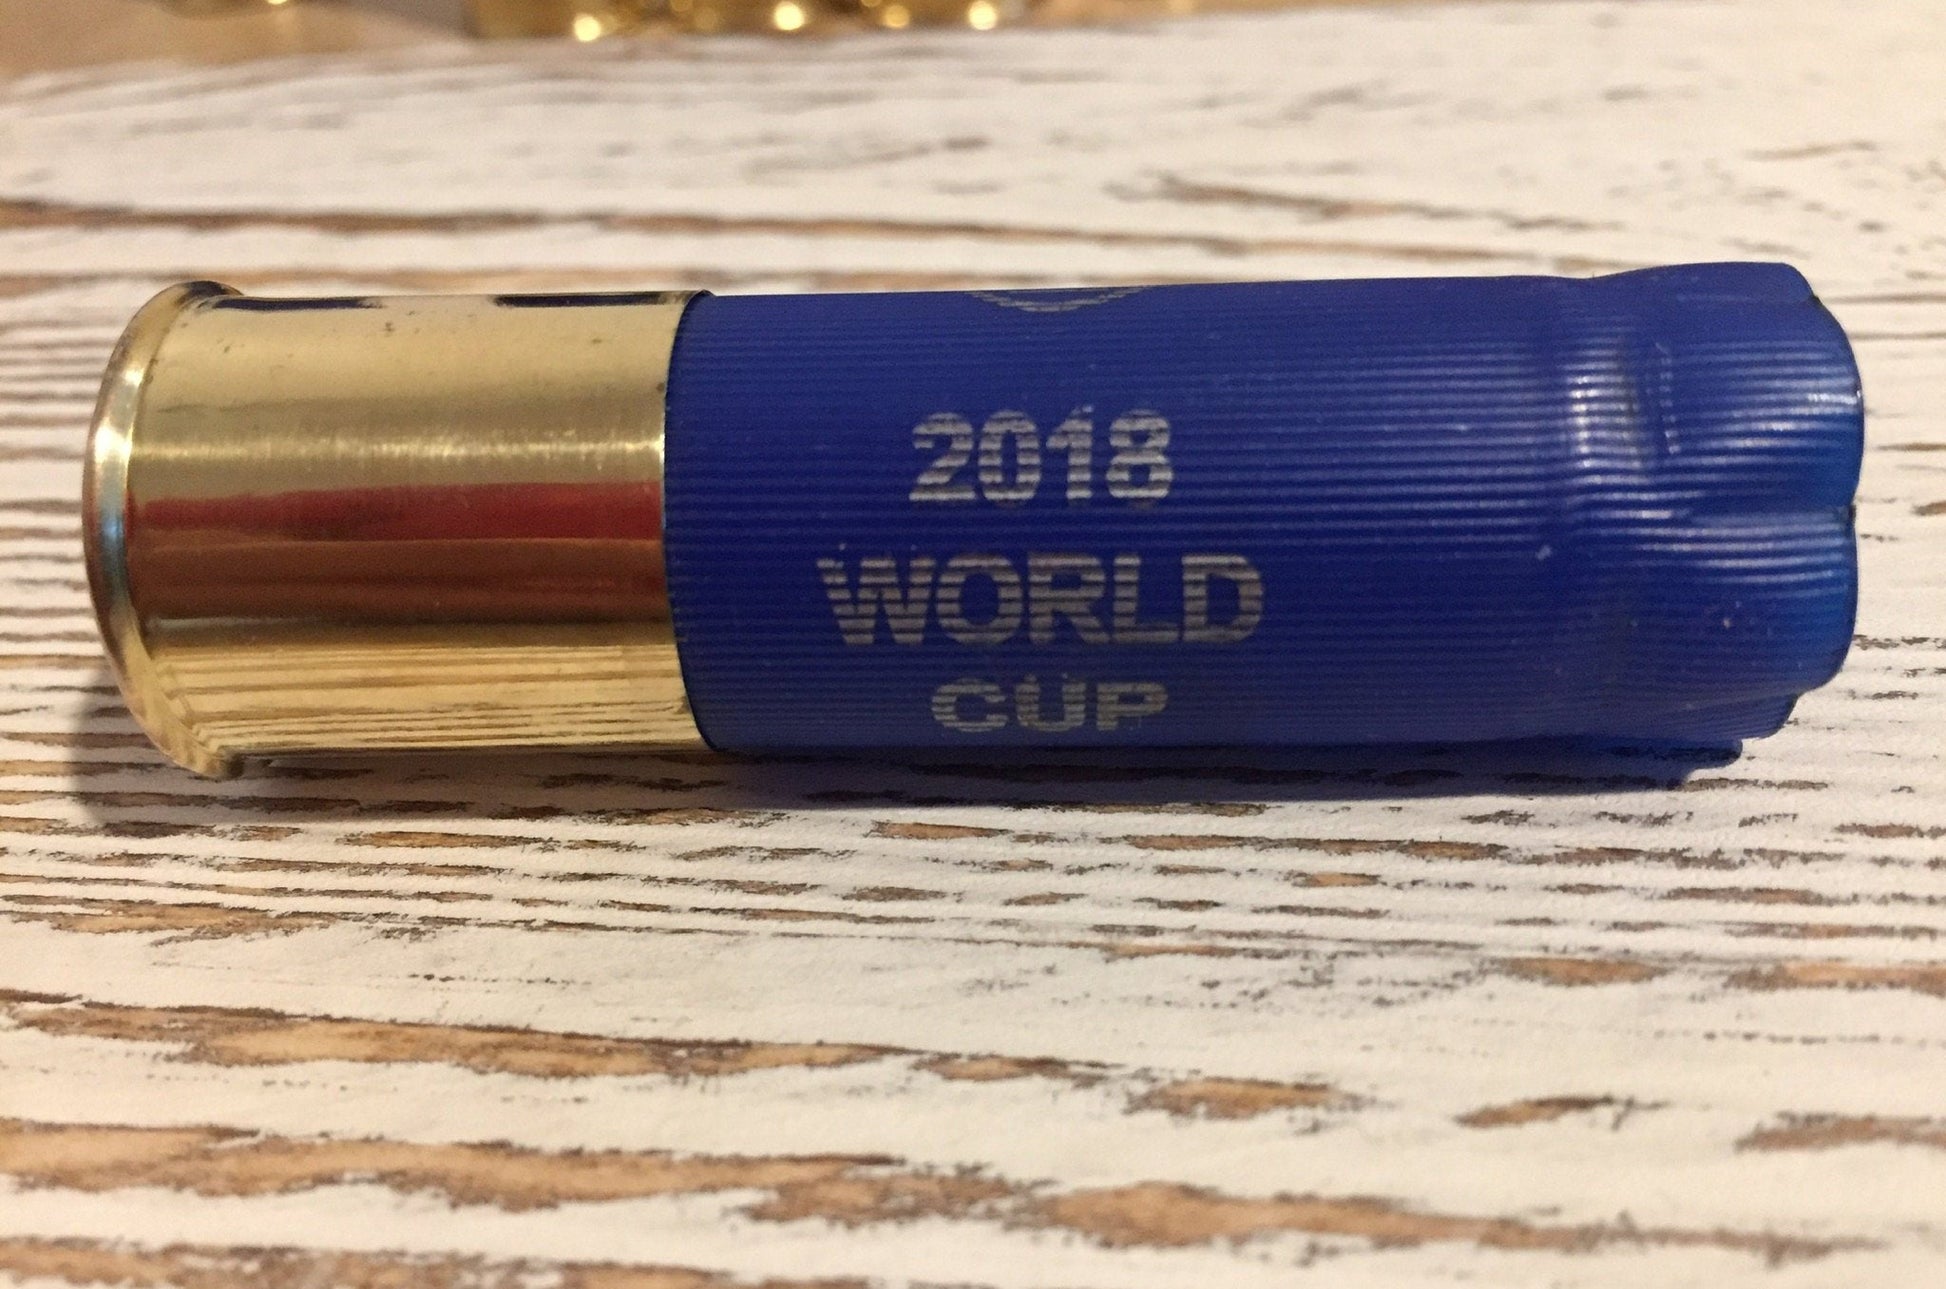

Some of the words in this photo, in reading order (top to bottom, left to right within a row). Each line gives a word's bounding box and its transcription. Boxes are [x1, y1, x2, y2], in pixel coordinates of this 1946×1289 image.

[908, 408, 1175, 505] 2018
[815, 551, 1265, 646] WORLD
[930, 677, 1169, 733] CUP
